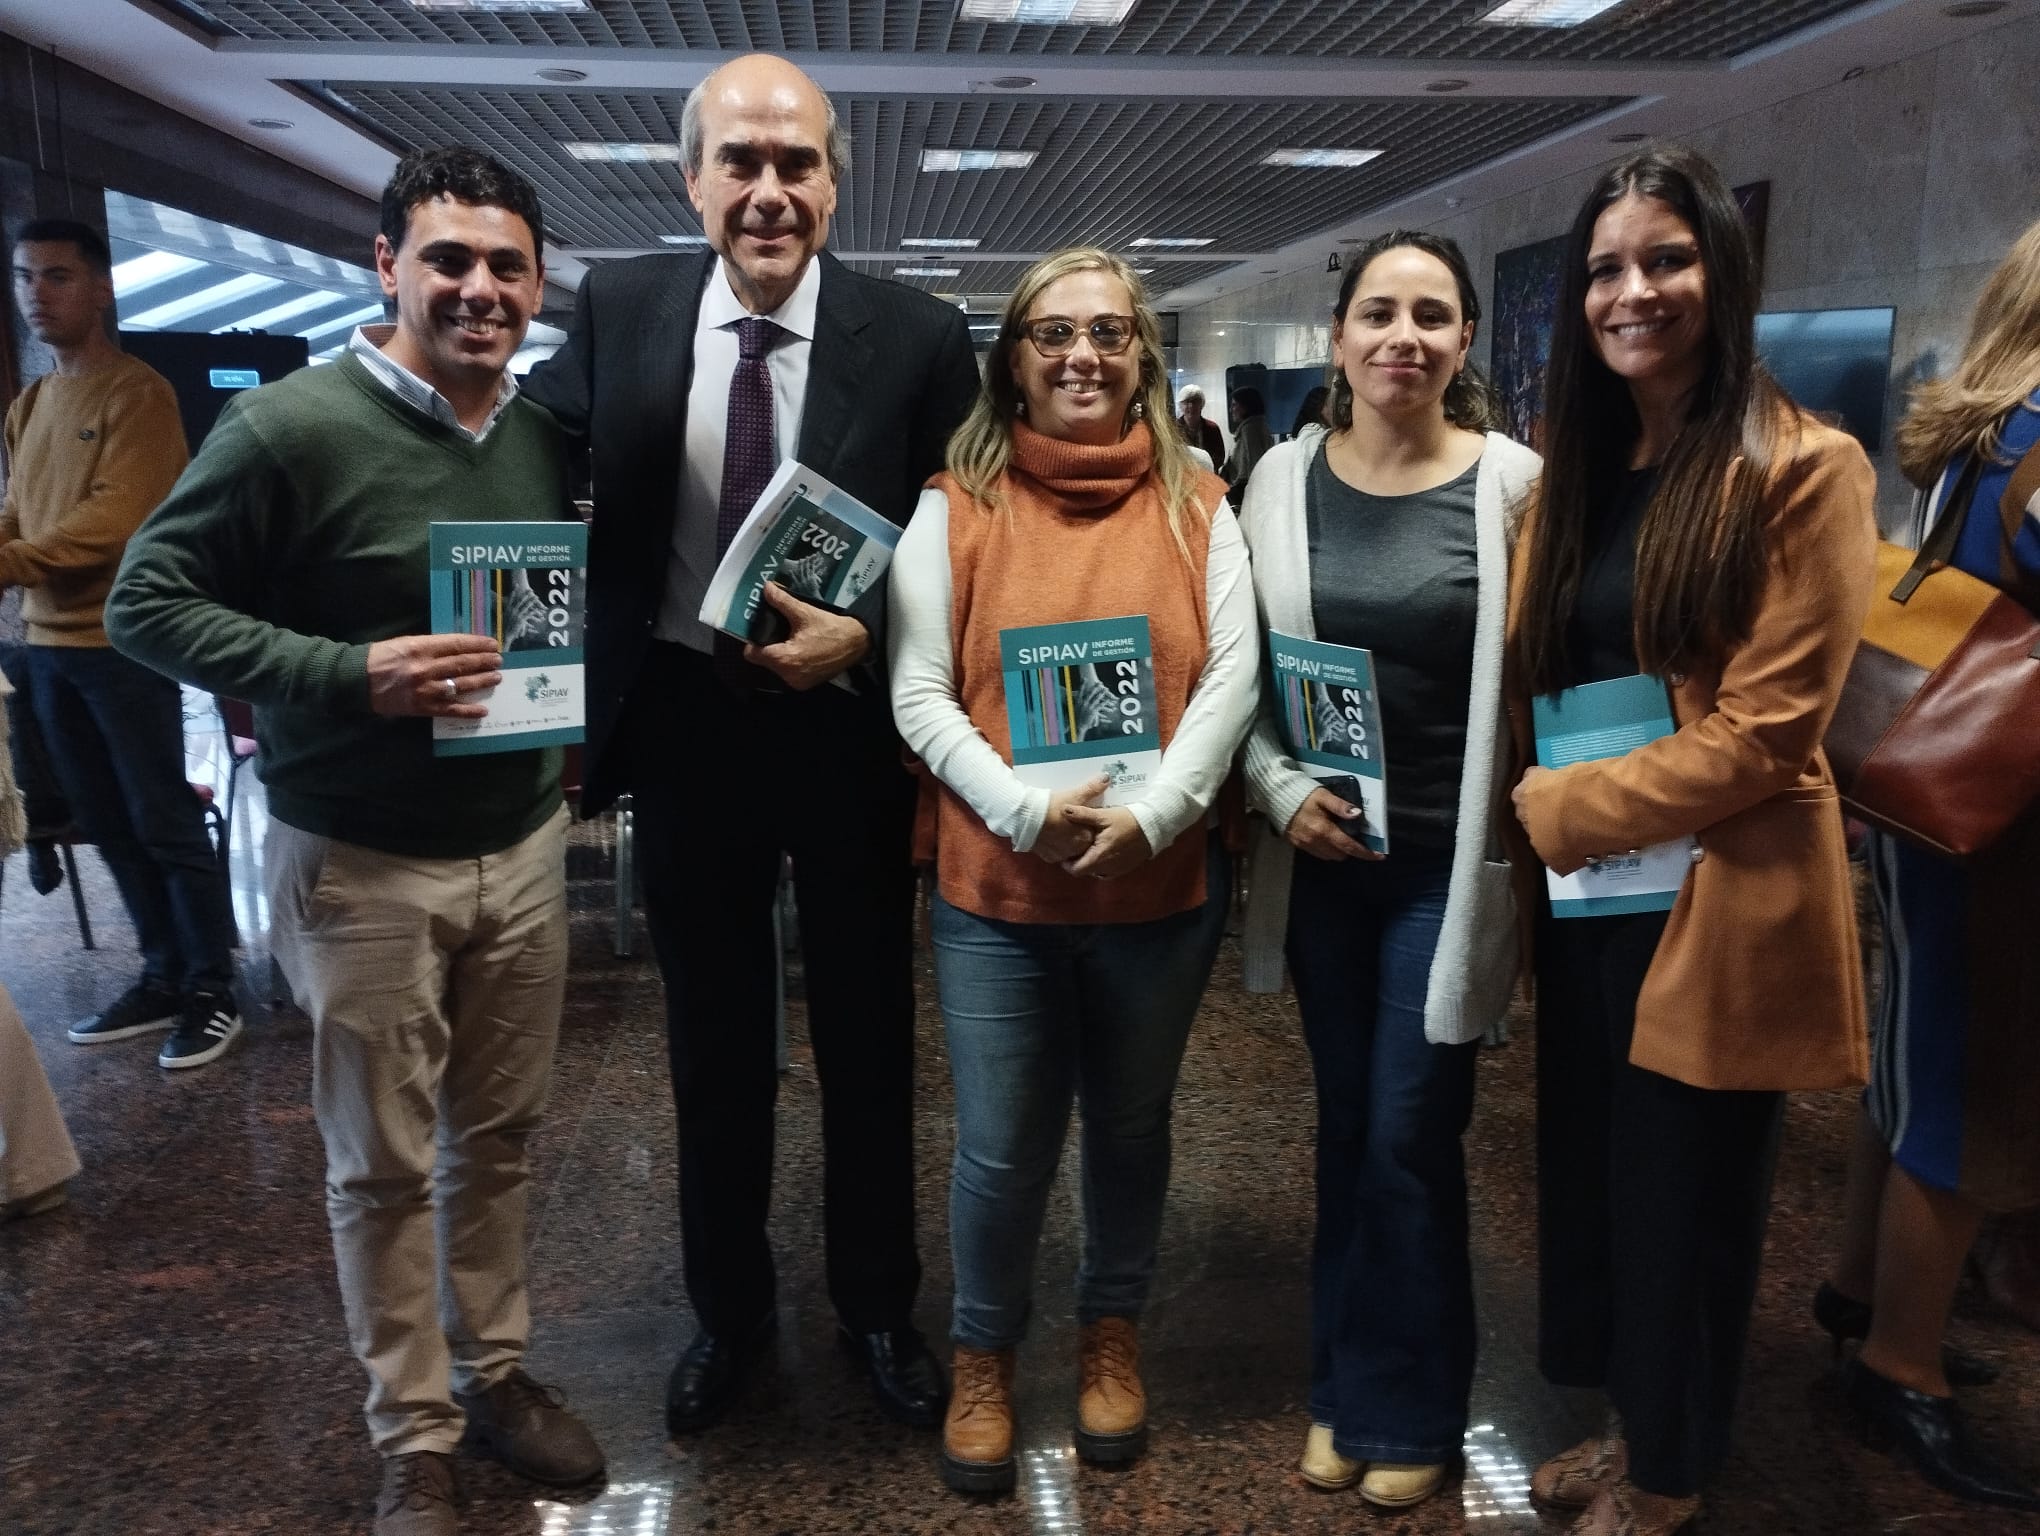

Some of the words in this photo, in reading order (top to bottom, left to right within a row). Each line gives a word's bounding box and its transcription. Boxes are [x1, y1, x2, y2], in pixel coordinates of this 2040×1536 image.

[451, 544, 522, 564] SIPIAV
[526, 545, 571, 554] INFORME
[800, 522, 851, 561] 2022
[743, 555, 779, 620] SIPIAV
[548, 568, 571, 648] 2022
[1018, 642, 1088, 665] SIPIAV
[1091, 638, 1134, 649] INFORME
[1276, 652, 1320, 676] SIPIAV
[1322, 664, 1356, 675] INFORME
[540, 688, 569, 698] SIPIAV
[1116, 660, 1144, 735] 2022
[1341, 687, 1369, 760] 2022
[1118, 773, 1146, 785] SIPIAV
